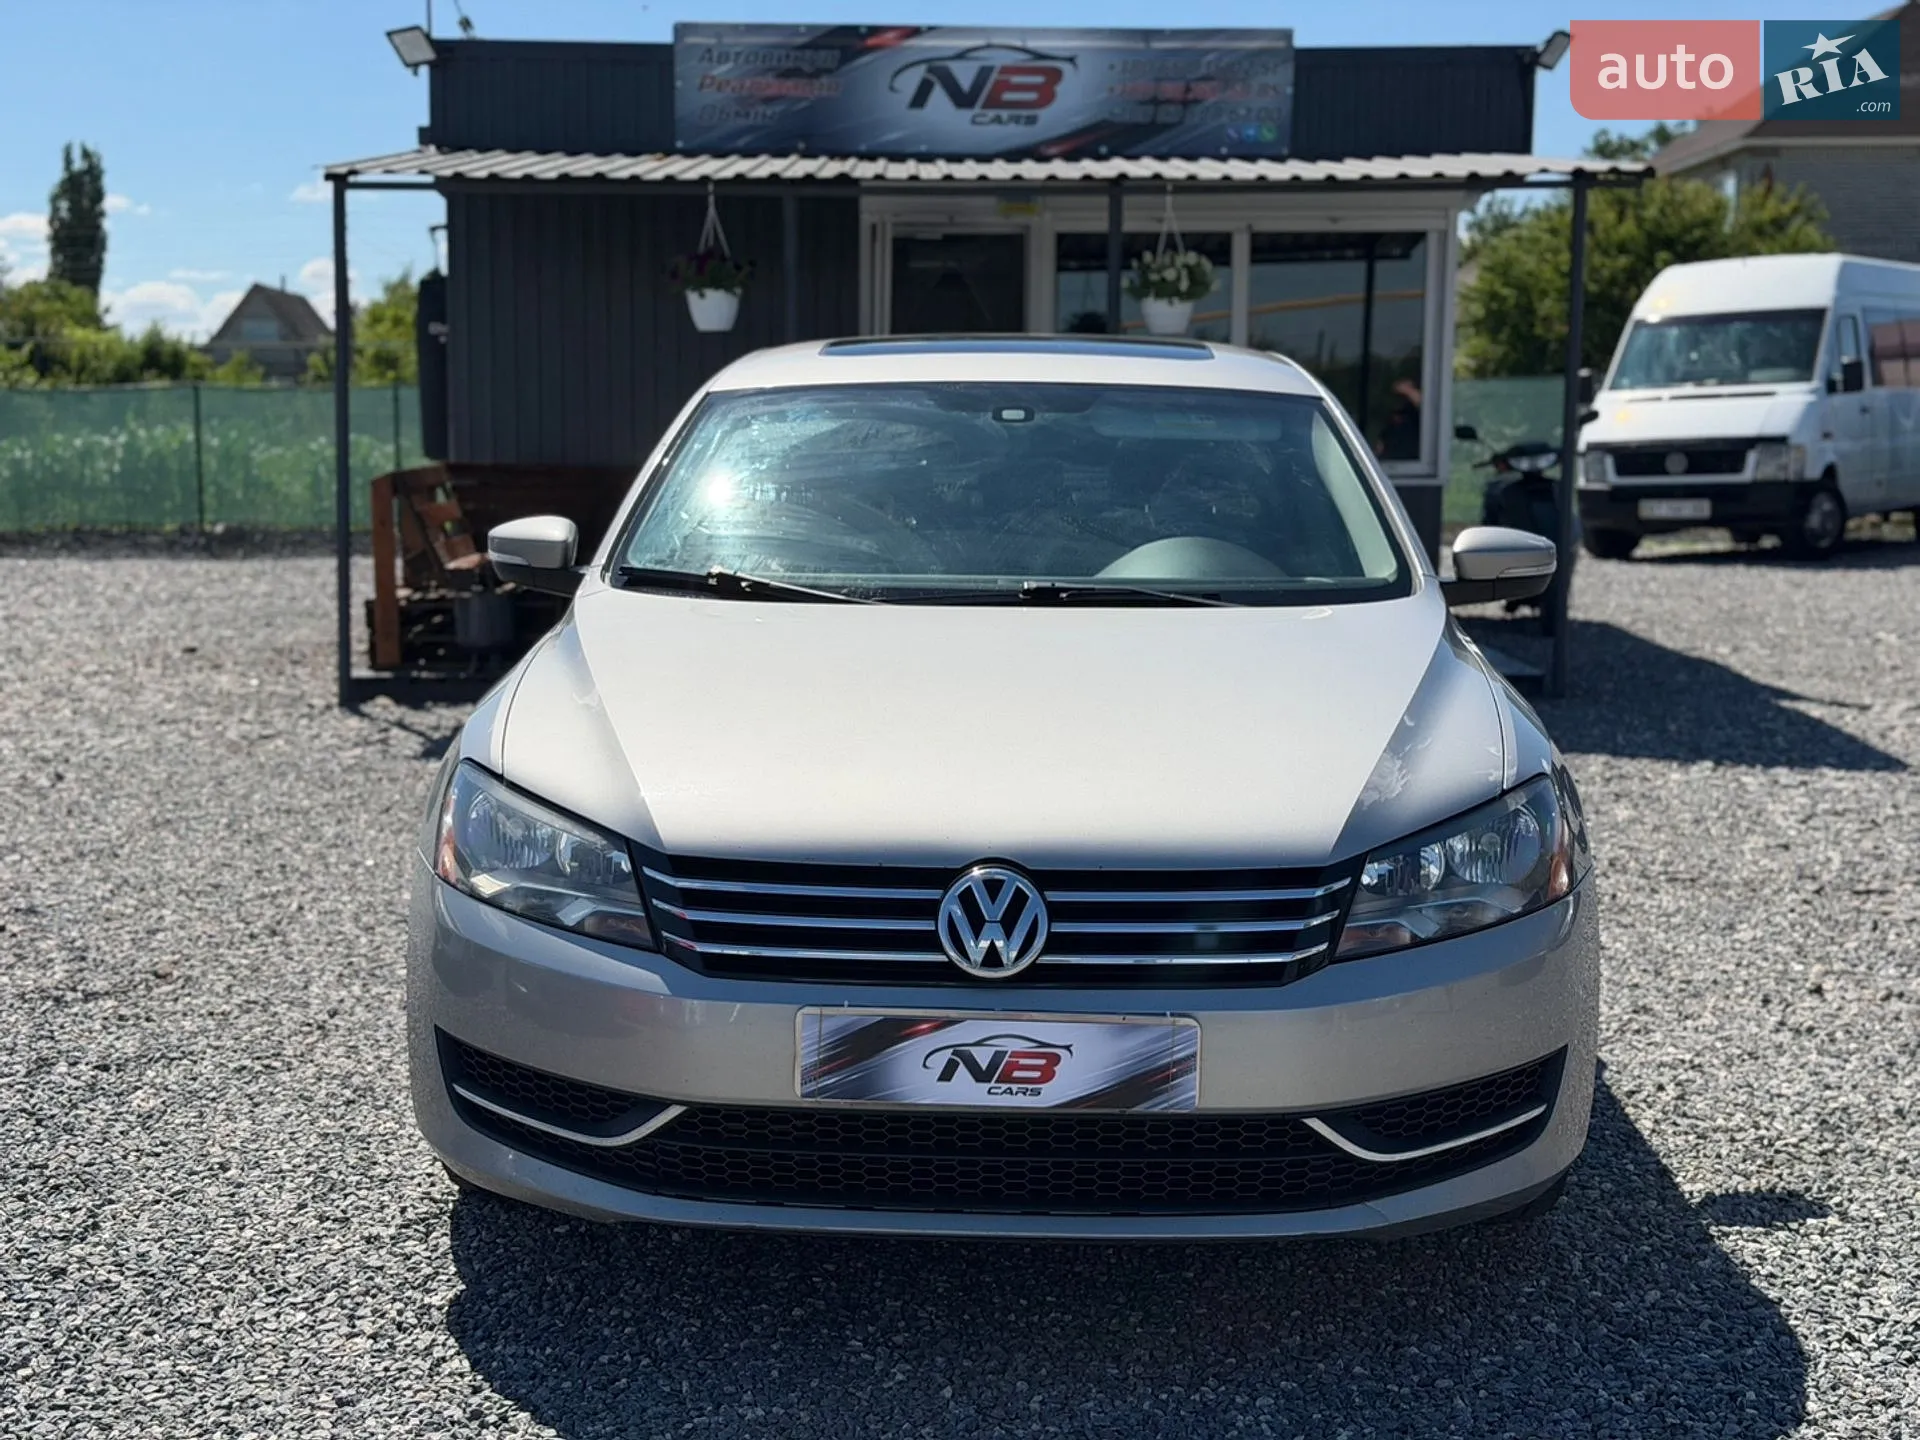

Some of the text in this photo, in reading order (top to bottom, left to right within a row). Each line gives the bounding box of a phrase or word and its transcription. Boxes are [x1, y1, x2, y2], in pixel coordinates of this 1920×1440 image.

[907, 65, 1063, 110] NB
[970, 113, 1039, 126] CARS
[936, 1049, 1061, 1085] NB
[986, 1086, 1043, 1097] CARS
